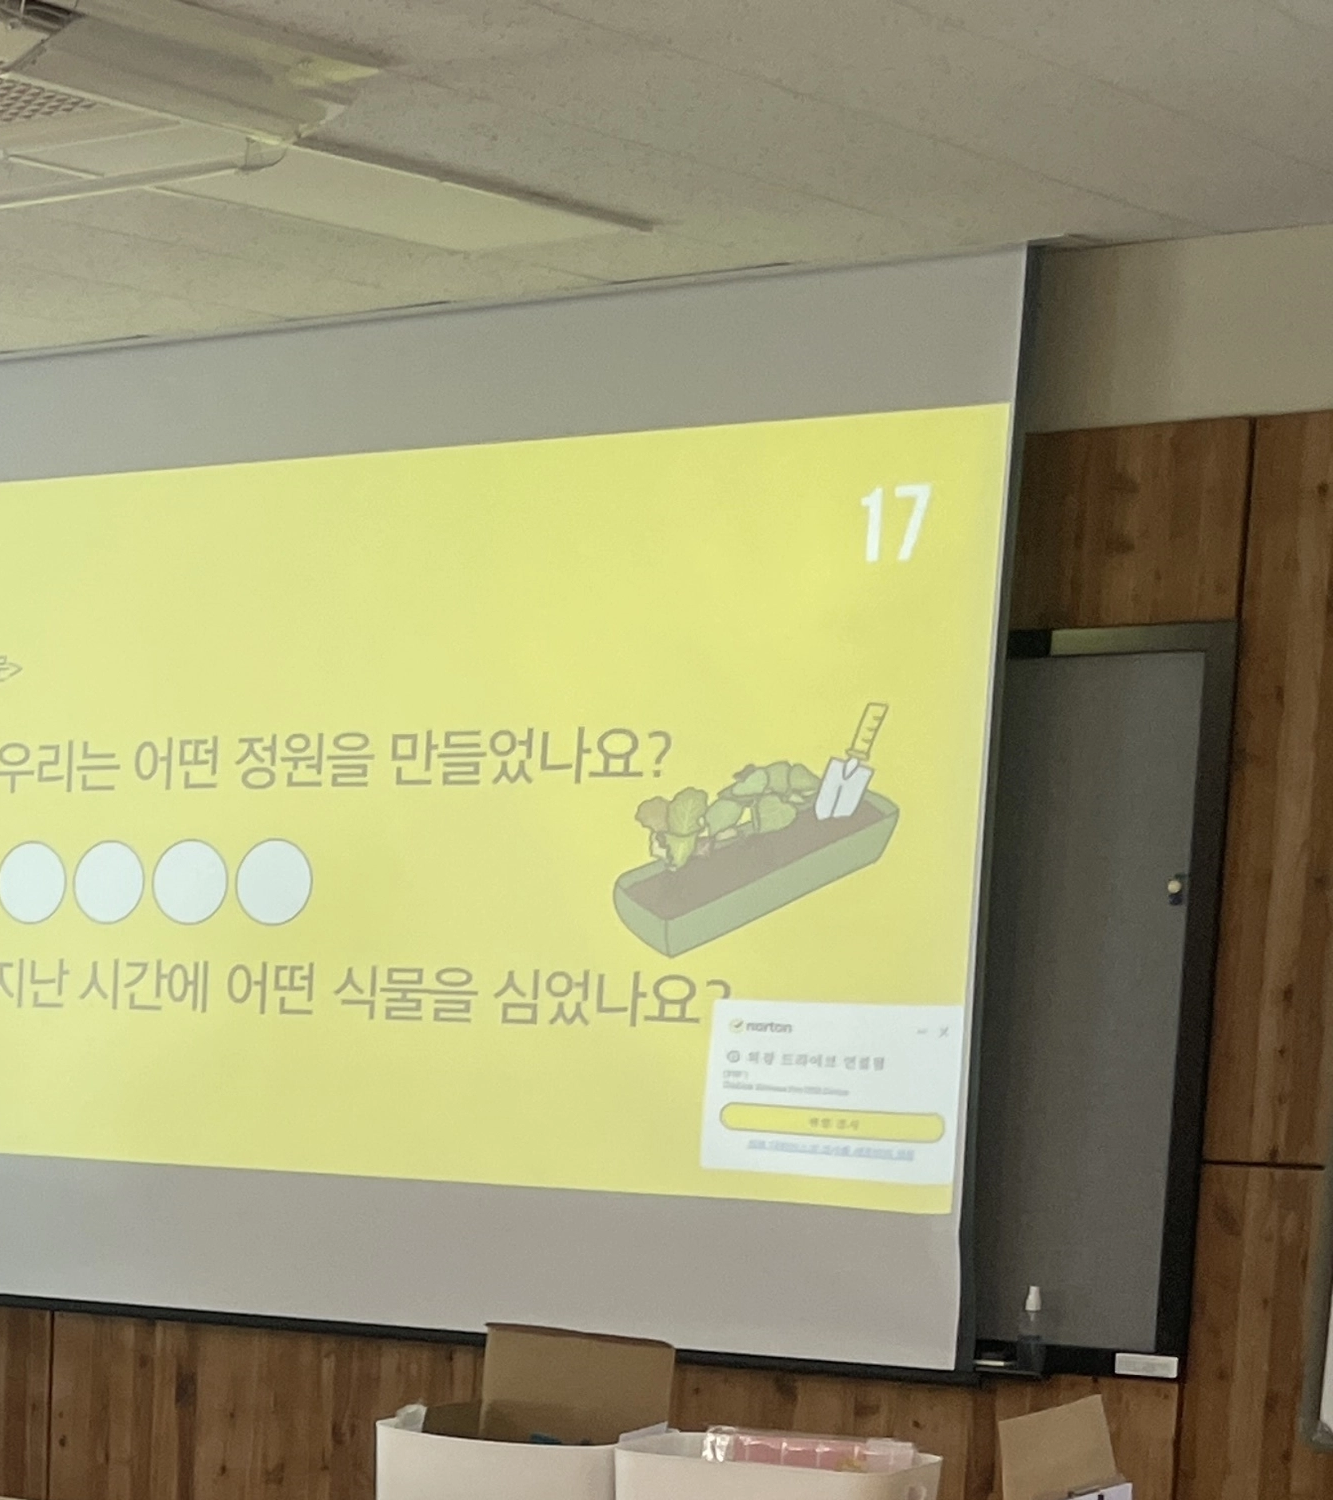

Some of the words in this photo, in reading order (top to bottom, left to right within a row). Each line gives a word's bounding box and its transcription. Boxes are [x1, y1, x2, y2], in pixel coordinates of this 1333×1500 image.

[860, 484, 931, 563] 17
[134, 735, 219, 790] 어떤
[235, 731, 375, 788] 정원을
[391, 726, 672, 786] 만들었나요?
[78, 958, 209, 1013] 시간에
[227, 961, 315, 1015] 어떤
[333, 965, 479, 1024] 식물을
[746, 1020, 793, 1034] norton
